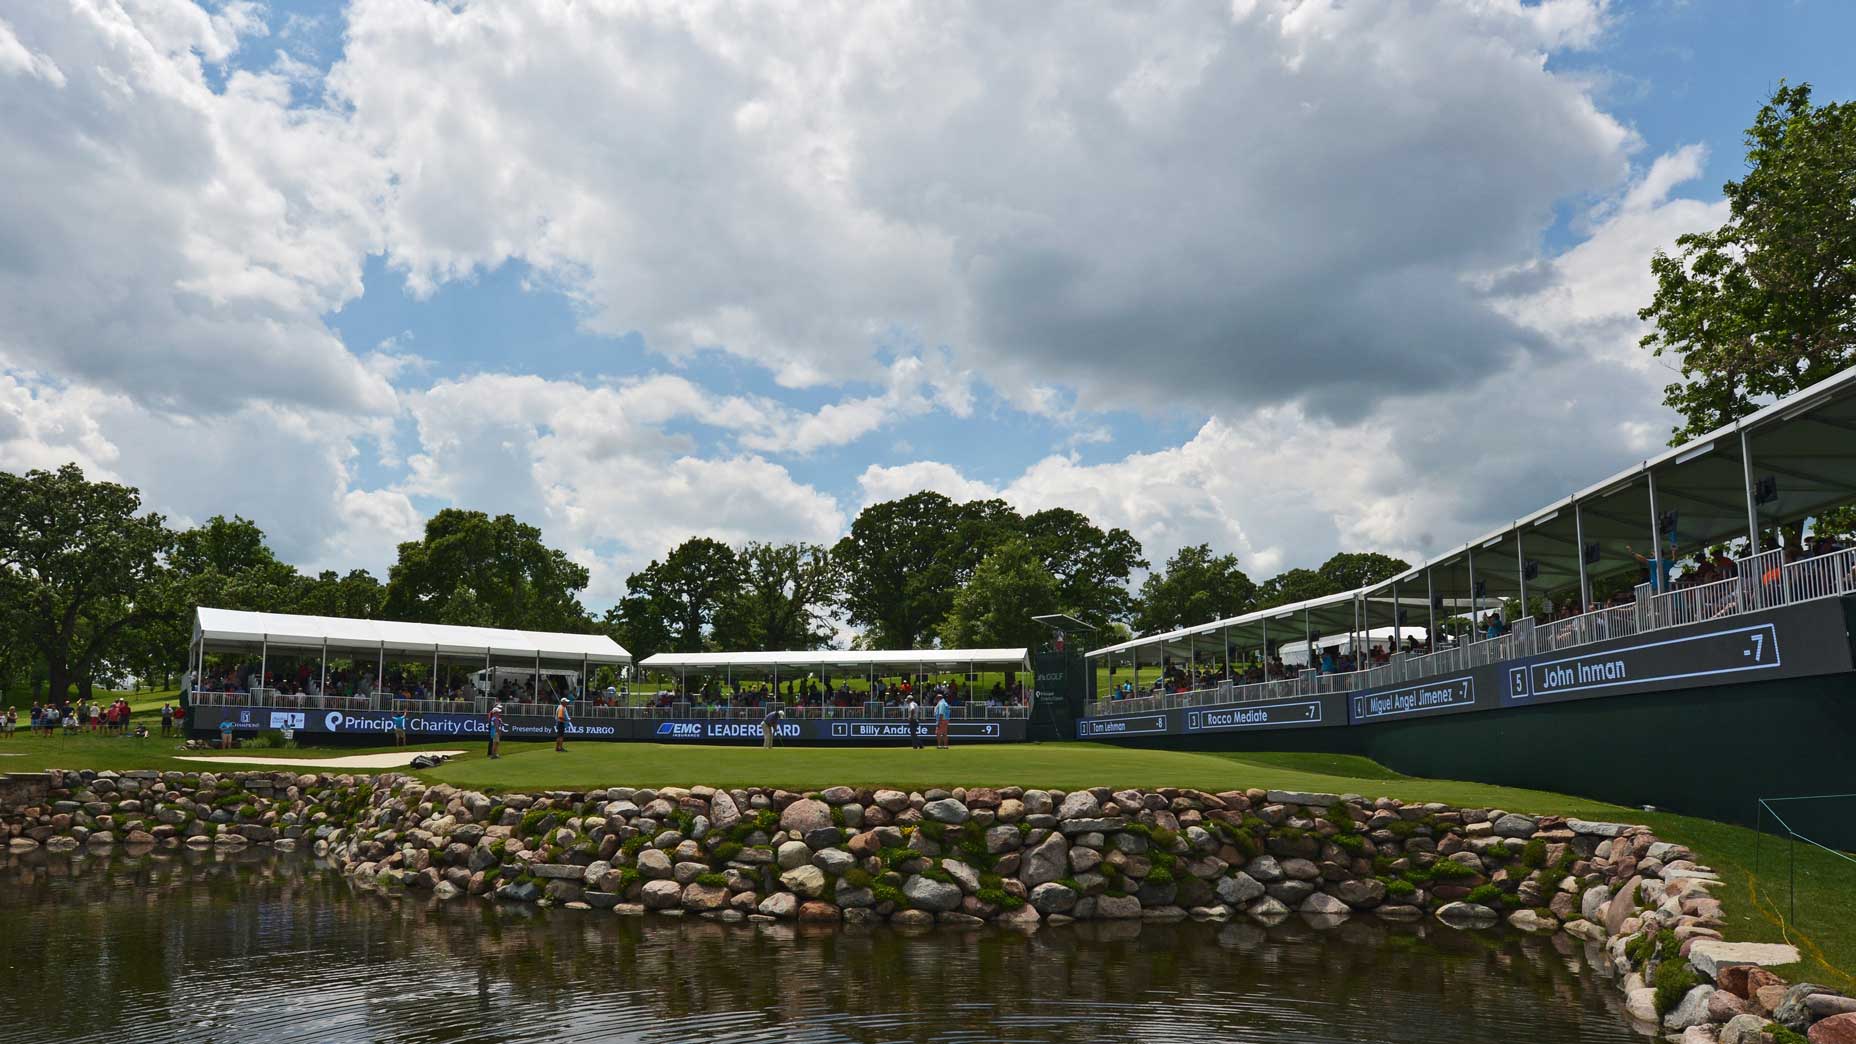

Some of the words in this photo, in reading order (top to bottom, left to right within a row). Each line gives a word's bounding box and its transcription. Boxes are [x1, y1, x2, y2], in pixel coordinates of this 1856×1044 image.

[1515, 676, 1523, 692] 5
[1543, 667, 1574, 688] John
[1577, 659, 1626, 683] Inman
[1743, 634, 1764, 662] -7
[1356, 703, 1362, 713] 4
[1370, 695, 1393, 714] Miguel
[1395, 691, 1417, 711] Angel
[1418, 688, 1453, 706] Jimenez
[1459, 681, 1469, 699] -7
[1191, 716, 1196, 726] 3
[1207, 713, 1231, 725] Rocco
[1234, 709, 1268, 723] Mediate
[1305, 705, 1315, 718] -7
[410, 718, 461, 734] Charity
[463, 719, 509, 732] Clasc
[512, 724, 544, 733] Presented
[544, 724, 552, 734] by
[586, 726, 615, 734] FARGO
[673, 723, 702, 734] EMC
[707, 724, 800, 737] LEADERBARD
[837, 726, 842, 734] 1
[860, 725, 880, 736] Billy
[981, 726, 992, 735] -9
[1093, 723, 1104, 733] Tom
[1104, 721, 1126, 732] Lehman
[1156, 717, 1163, 728] -8
